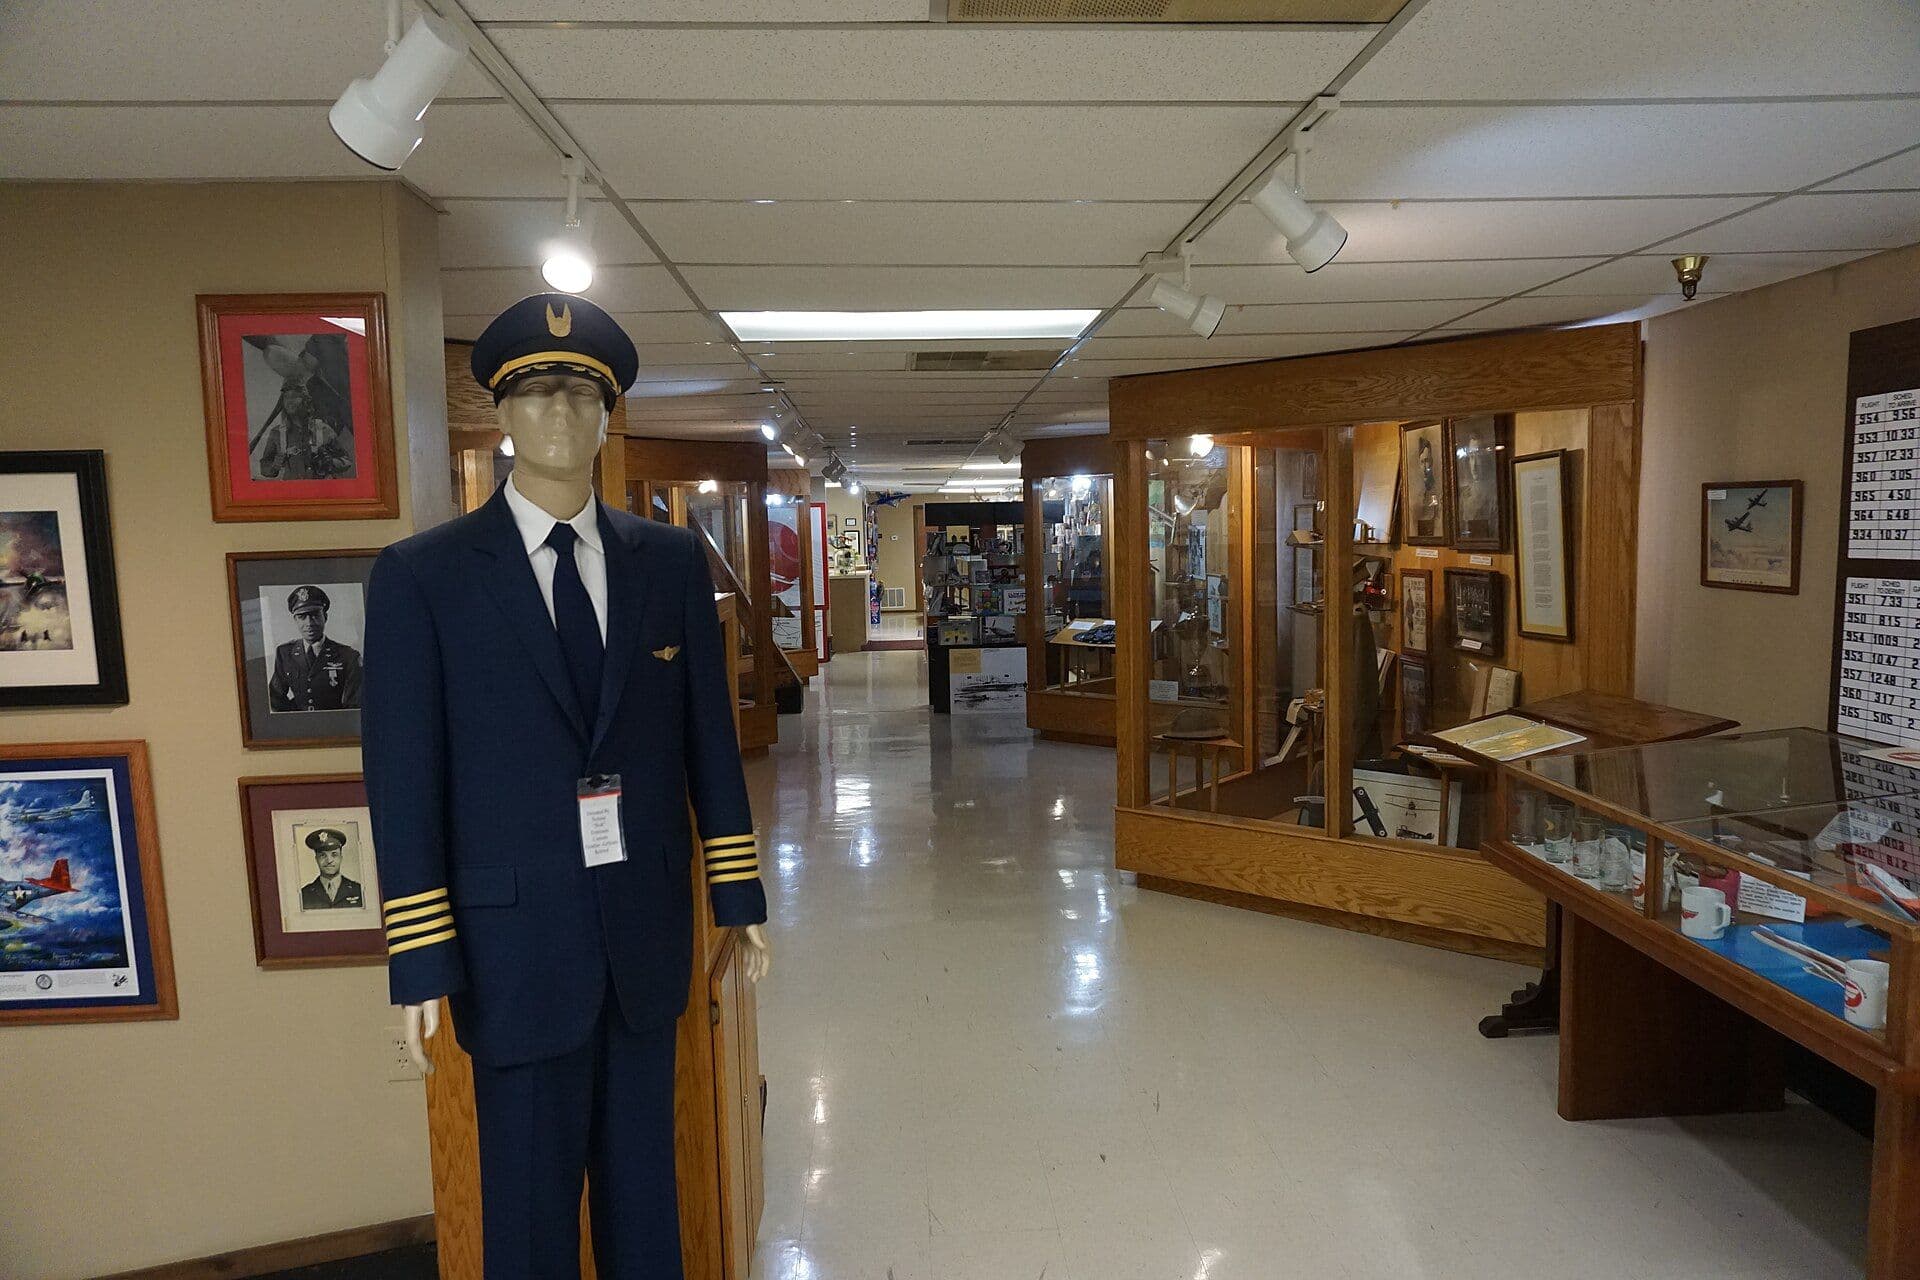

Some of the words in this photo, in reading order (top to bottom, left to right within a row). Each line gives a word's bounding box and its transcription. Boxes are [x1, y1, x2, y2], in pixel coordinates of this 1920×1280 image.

[1860, 414, 1879, 424] 954
[1859, 433, 1878, 443] 953
[1858, 452, 1877, 462] 957
[1856, 472, 1876, 482] 960
[1855, 491, 1875, 501] 965
[1854, 510, 1874, 520] 964
[1852, 530, 1872, 540] 934
[1848, 594, 1866, 604] 951
[1848, 613, 1867, 623] 950
[1846, 632, 1864, 642] 954
[1913, 638, 1920, 648] 2
[1844, 650, 1863, 661] 953
[1912, 658, 1918, 669] 2
[1843, 669, 1862, 680] 957
[1911, 678, 1918, 688] 2
[1842, 688, 1862, 699] 960
[1910, 698, 1916, 709] 2
[1841, 706, 1860, 718] 965
[1908, 718, 1914, 729] 2
